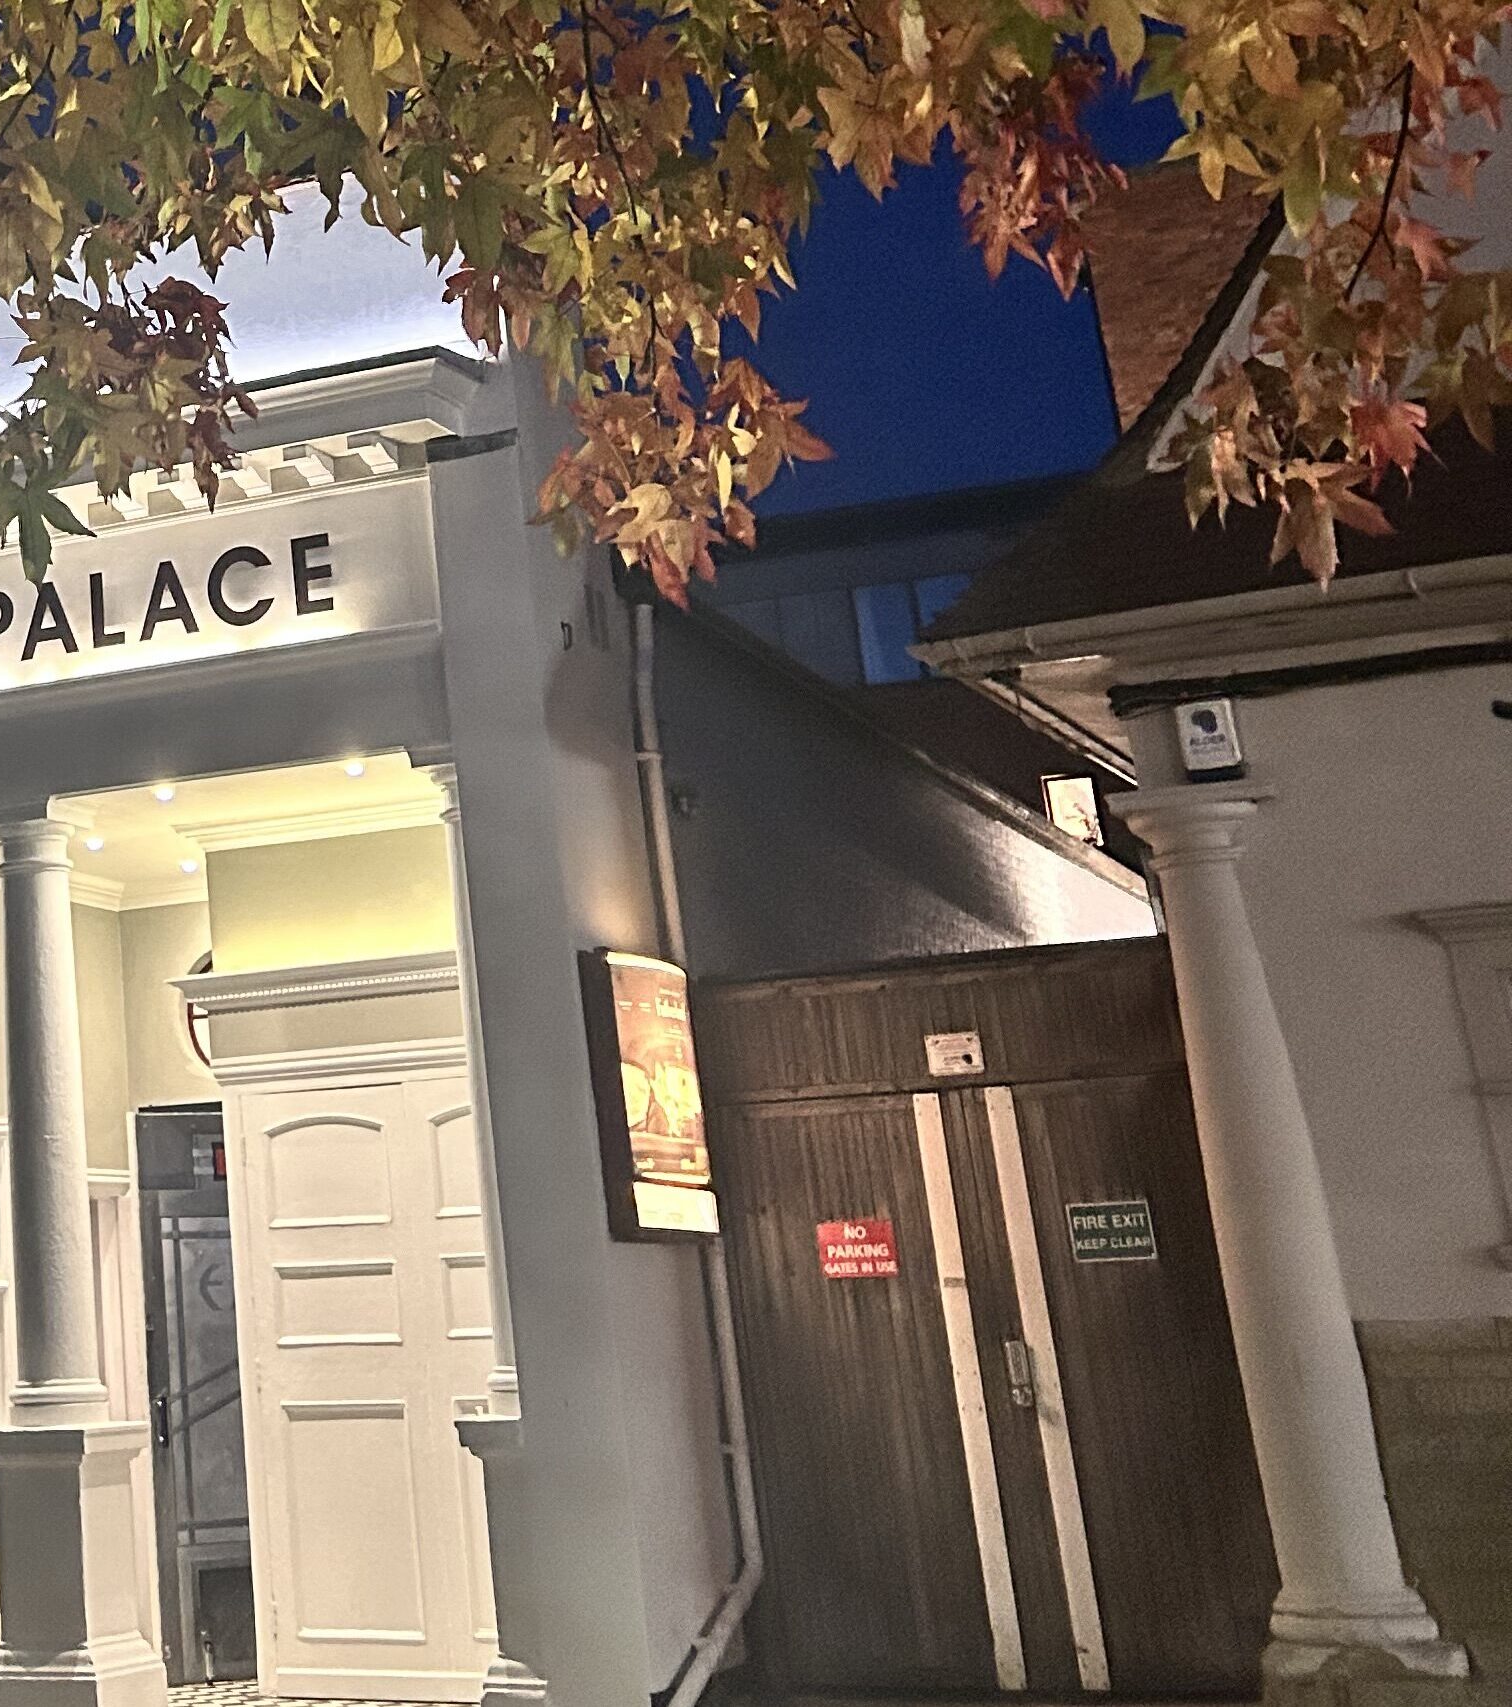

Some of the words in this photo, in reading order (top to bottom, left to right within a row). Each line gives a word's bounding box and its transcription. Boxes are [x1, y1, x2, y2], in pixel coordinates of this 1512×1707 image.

[1073, 1214, 1108, 1230] FIRE
[1111, 1212, 1146, 1228] EXIT
[843, 1223, 866, 1240] NO
[1076, 1237, 1108, 1250] KEEP
[1110, 1235, 1151, 1249] CLEAR
[827, 1243, 889, 1258] PARKING
[824, 1262, 858, 1274] GATES
[861, 1262, 874, 1273] IN
[875, 1260, 898, 1273] USE
